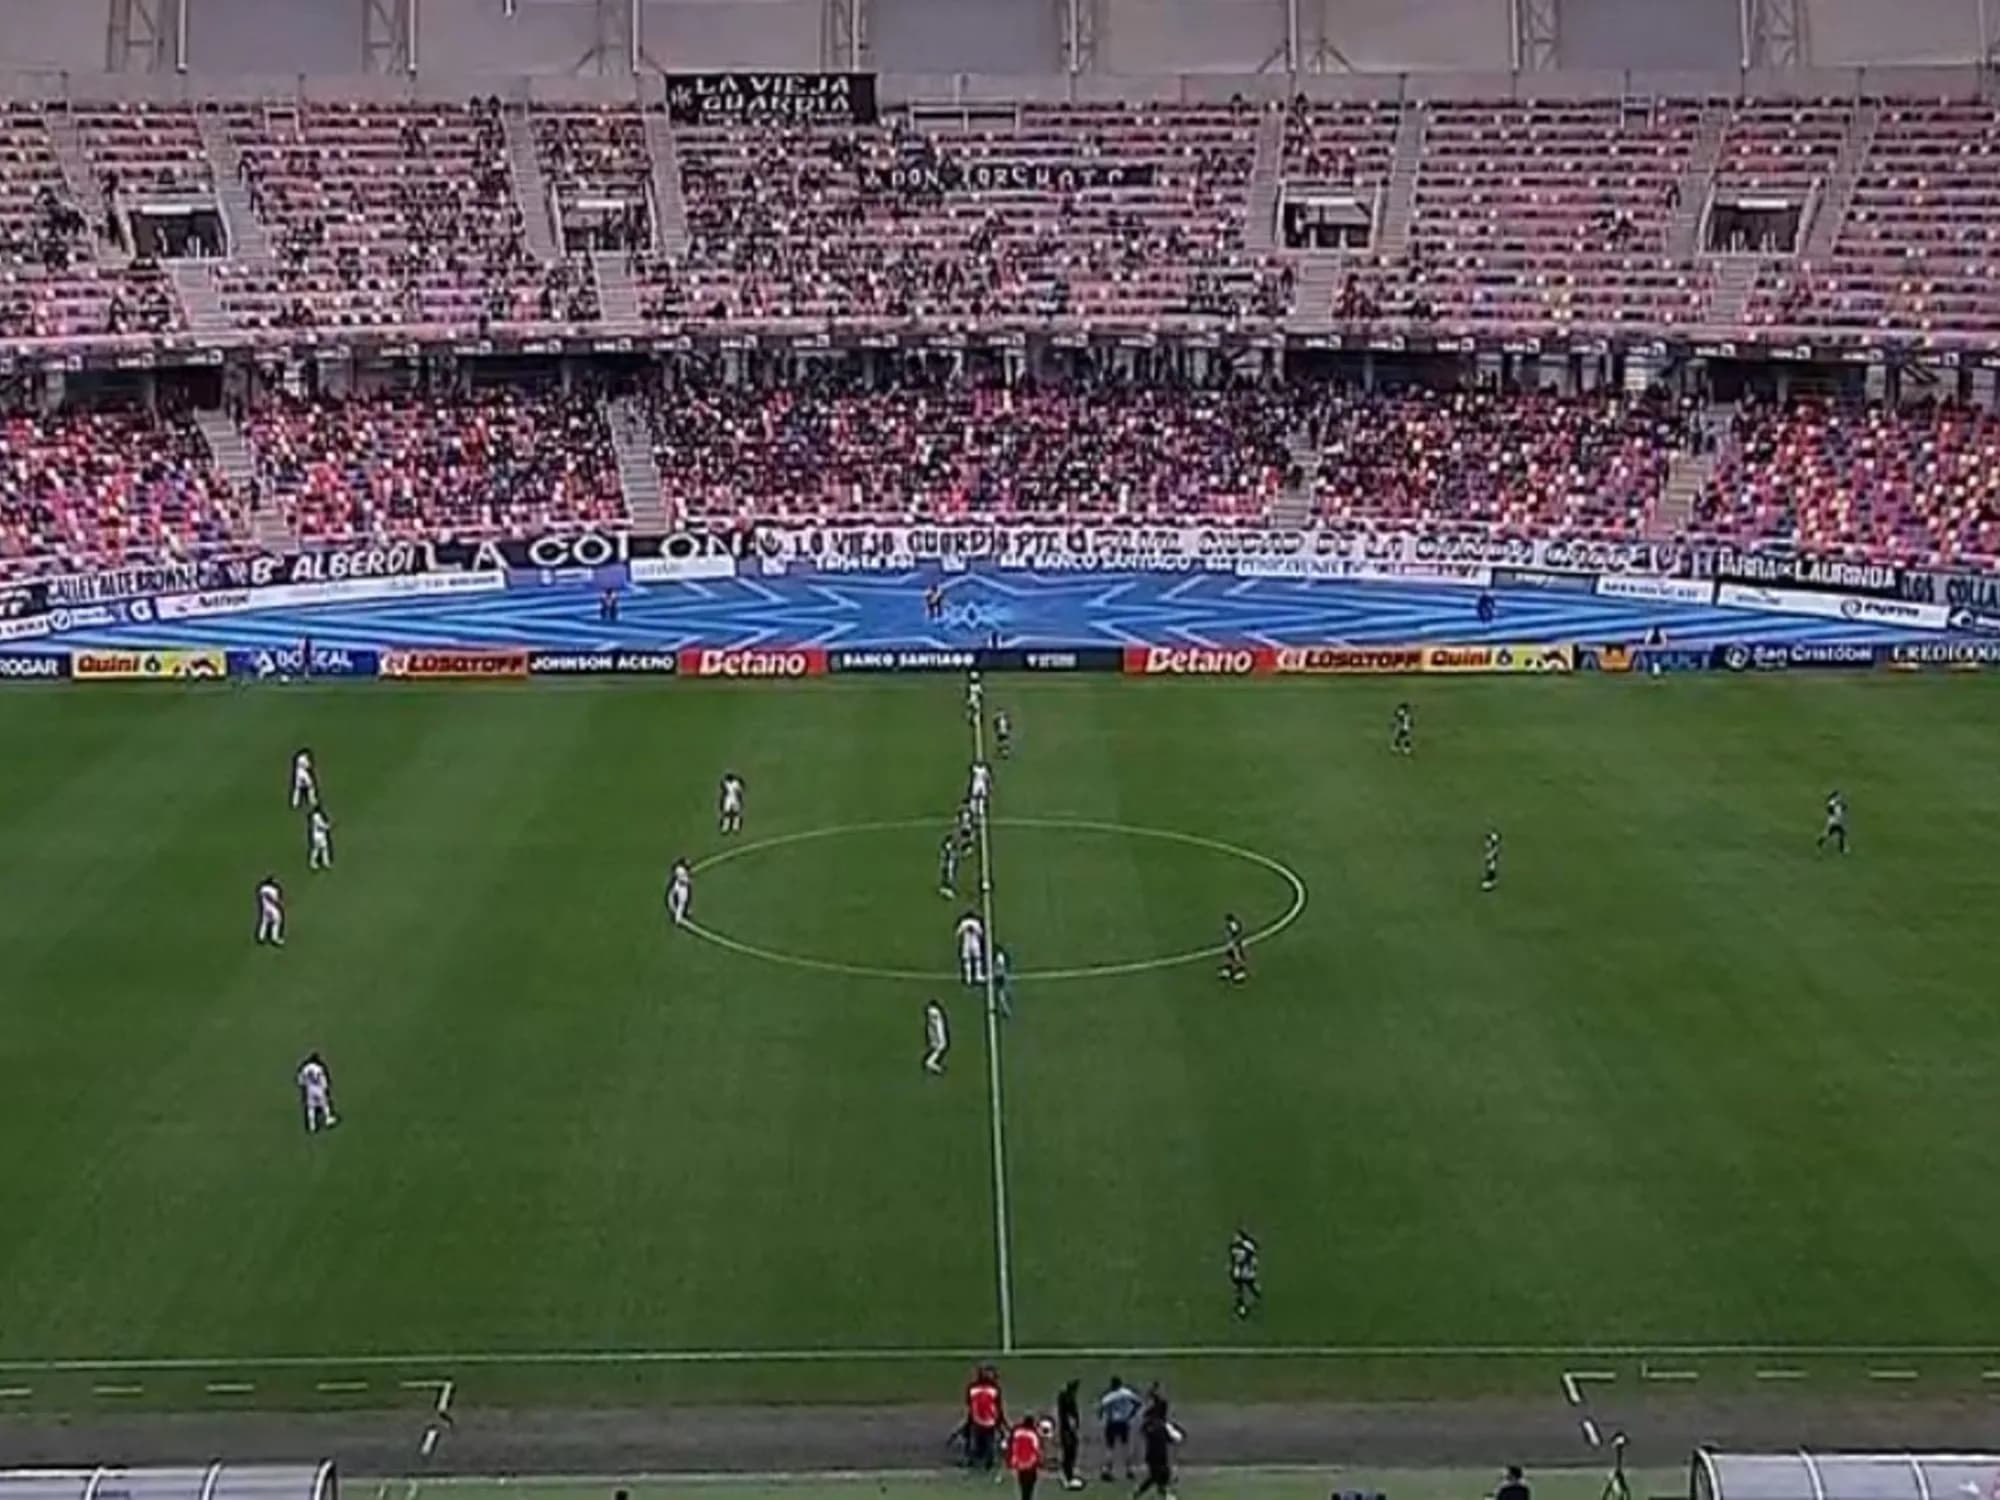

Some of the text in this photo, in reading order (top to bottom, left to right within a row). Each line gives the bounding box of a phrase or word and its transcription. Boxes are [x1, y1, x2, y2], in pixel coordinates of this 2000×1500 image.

[696, 76, 850, 95] LA VIEJA
[290, 542, 416, 579] ALBERDI
[77, 654, 139, 675] Quini
[530, 655, 675, 671] JOHNSON ACERO
[698, 649, 806, 677] Betano
[843, 652, 975, 668] BANCO SANTIAGO
[1143, 647, 1253, 673] Betano
[1430, 650, 1490, 667] Quini
